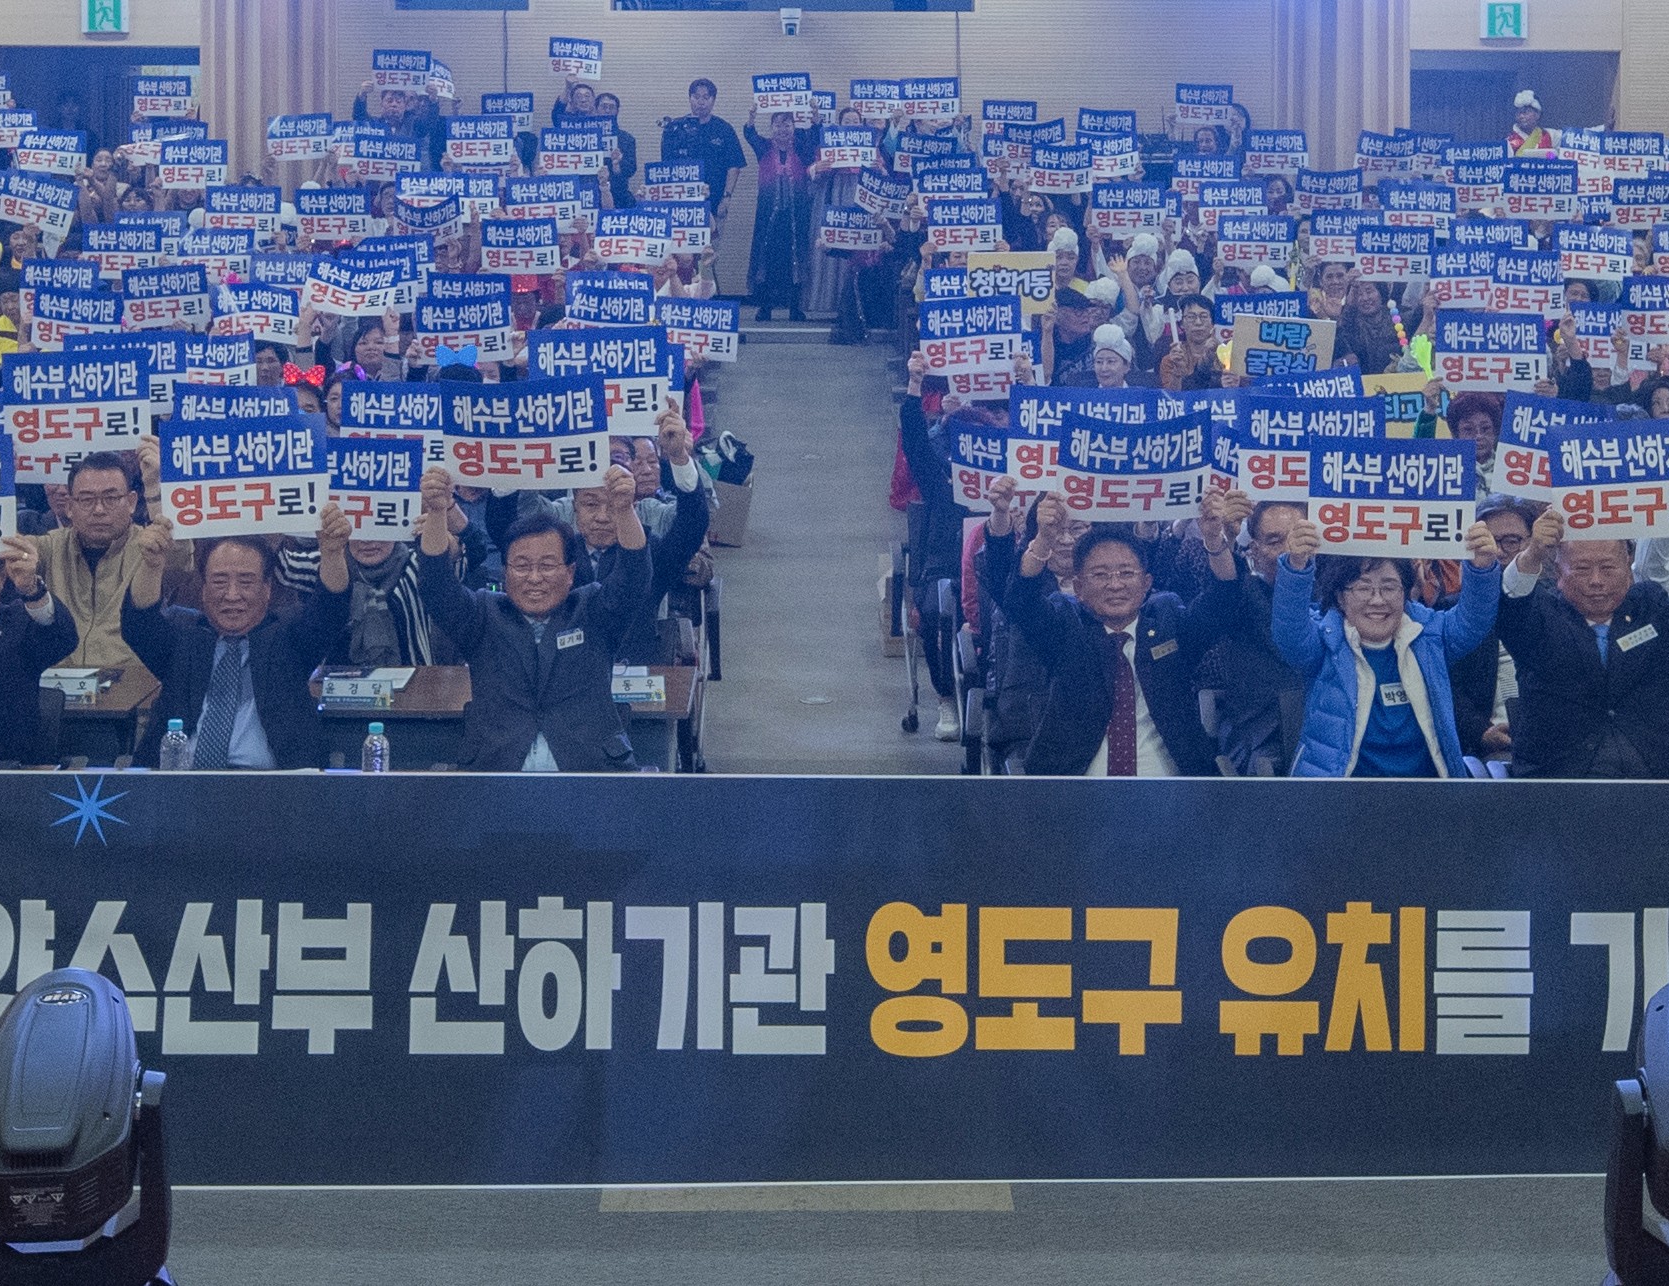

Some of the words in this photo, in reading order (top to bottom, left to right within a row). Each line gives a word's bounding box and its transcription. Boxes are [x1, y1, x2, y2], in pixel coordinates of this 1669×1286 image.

[164, 146, 188, 163] 해수부
[189, 145, 222, 163] 산하기관
[544, 133, 566, 150] 해수부
[567, 133, 598, 150] 산하기관
[162, 166, 221, 183] 영도구로!
[542, 153, 599, 169] 영도구로!
[933, 205, 960, 224] 해수부
[960, 204, 996, 224] 산하기관
[932, 228, 997, 246] 영도구로!
[1223, 220, 1251, 240] 해수부
[1251, 221, 1288, 241] 산하기관
[1221, 243, 1287, 262] 영도구로!
[970, 267, 1054, 301] 청학1동
[928, 308, 963, 336] 해수부
[964, 303, 1012, 334] 산하기관
[1260, 321, 1311, 349] 바람
[1444, 321, 1485, 350] 해수부
[1486, 322, 1538, 351] 산하기관
[926, 338, 1013, 367] 영도구로!
[1246, 349, 1317, 376] 굴렁쇠
[13, 364, 65, 400] 해수부
[67, 360, 138, 398] 산하기관
[1441, 356, 1540, 383] 영도구로!
[12, 407, 140, 443] 영도구로!
[453, 395, 511, 433] 해수부
[514, 392, 594, 432] 산하기관
[172, 434, 231, 476] 해수부
[234, 428, 313, 472] 산하기관
[452, 442, 597, 478] 영도구로!
[1068, 427, 1128, 470] 해수부
[1131, 424, 1205, 466] 산하기관
[1561, 437, 1622, 480] 해수부
[1322, 450, 1382, 493] 해수부
[1385, 453, 1464, 495] 산하기관
[170, 481, 317, 525] 영도구로!
[1062, 475, 1205, 513] 영도구로!
[1317, 503, 1463, 544] 영도구로!
[1385, 690, 1407, 703] 박영
[409, 896, 835, 1056] 산하기관
[865, 902, 1183, 1057] 영도구
[1220, 902, 1534, 1057] 유치를
